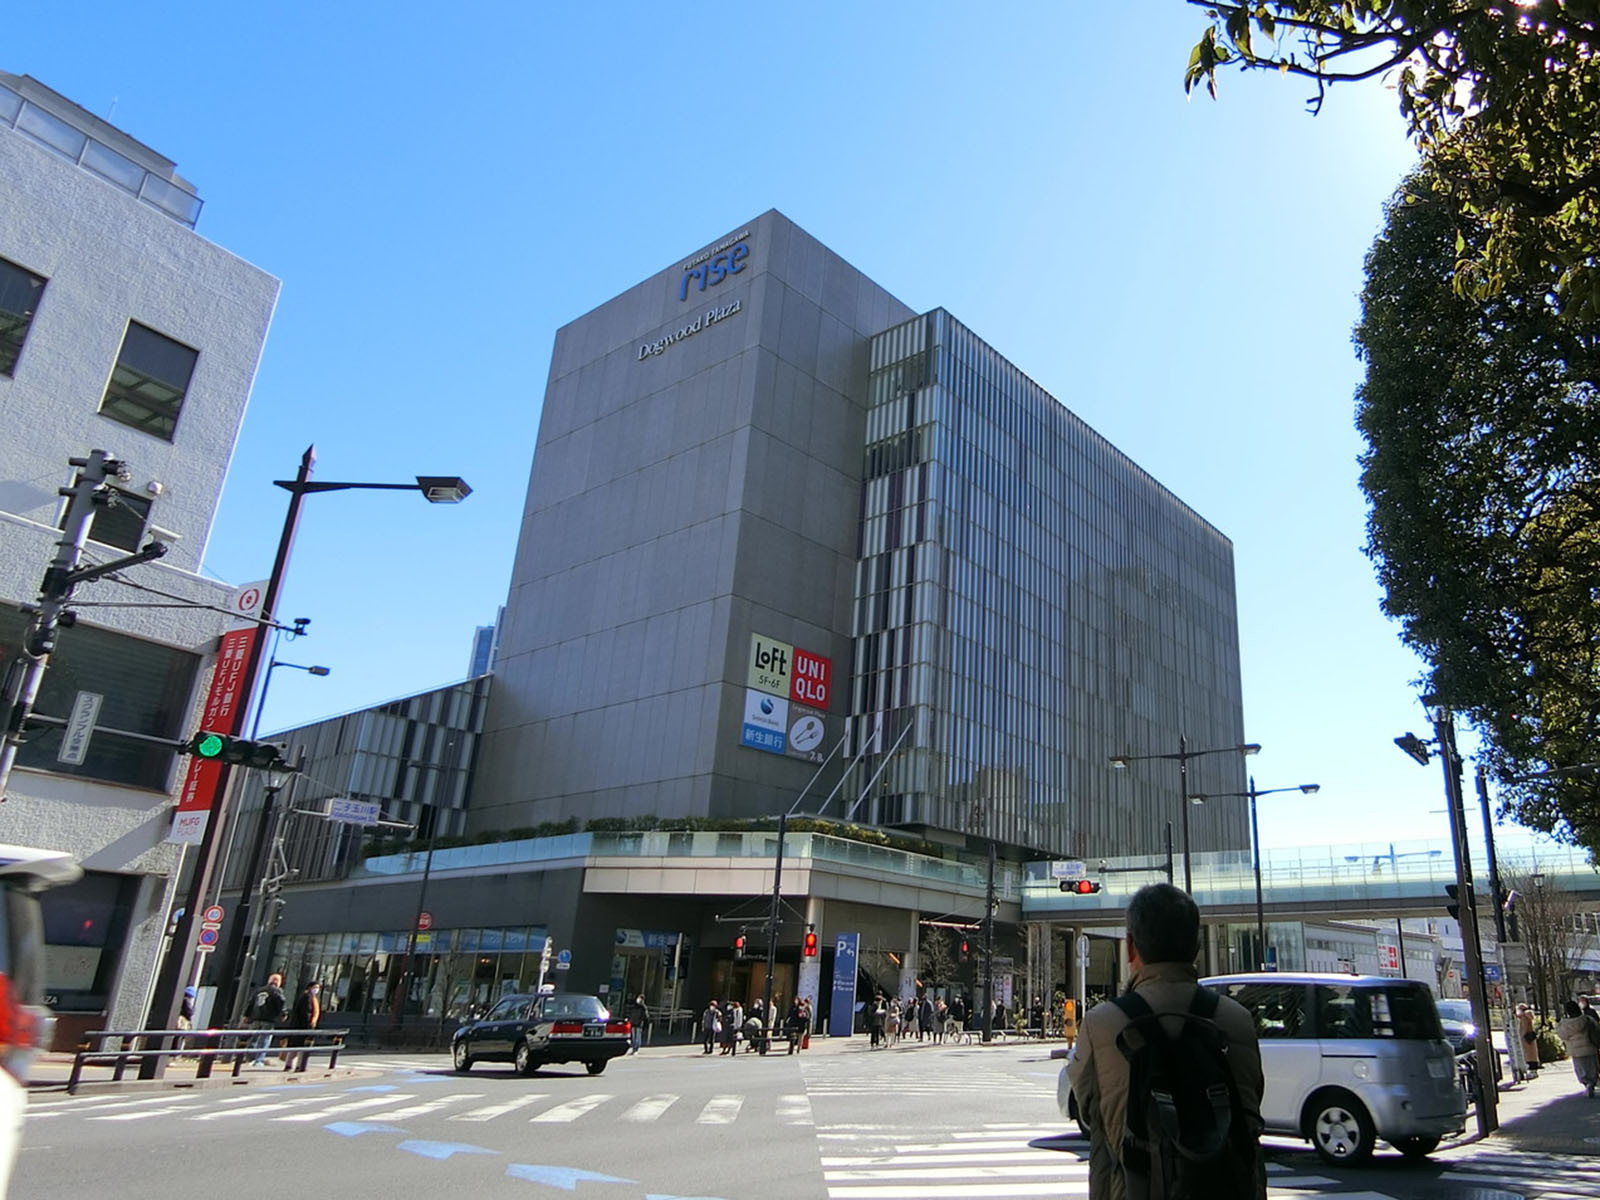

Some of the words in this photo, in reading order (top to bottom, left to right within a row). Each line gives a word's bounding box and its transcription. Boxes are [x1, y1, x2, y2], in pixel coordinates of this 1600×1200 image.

[680, 242, 749, 301] rise
[638, 316, 702, 361] Dogwood
[704, 300, 742, 328] Plaza
[797, 656, 825, 680] UNI
[795, 677, 826, 701] QLO
[744, 728, 783, 749] 新生銀行
[836, 940, 848, 957] P
